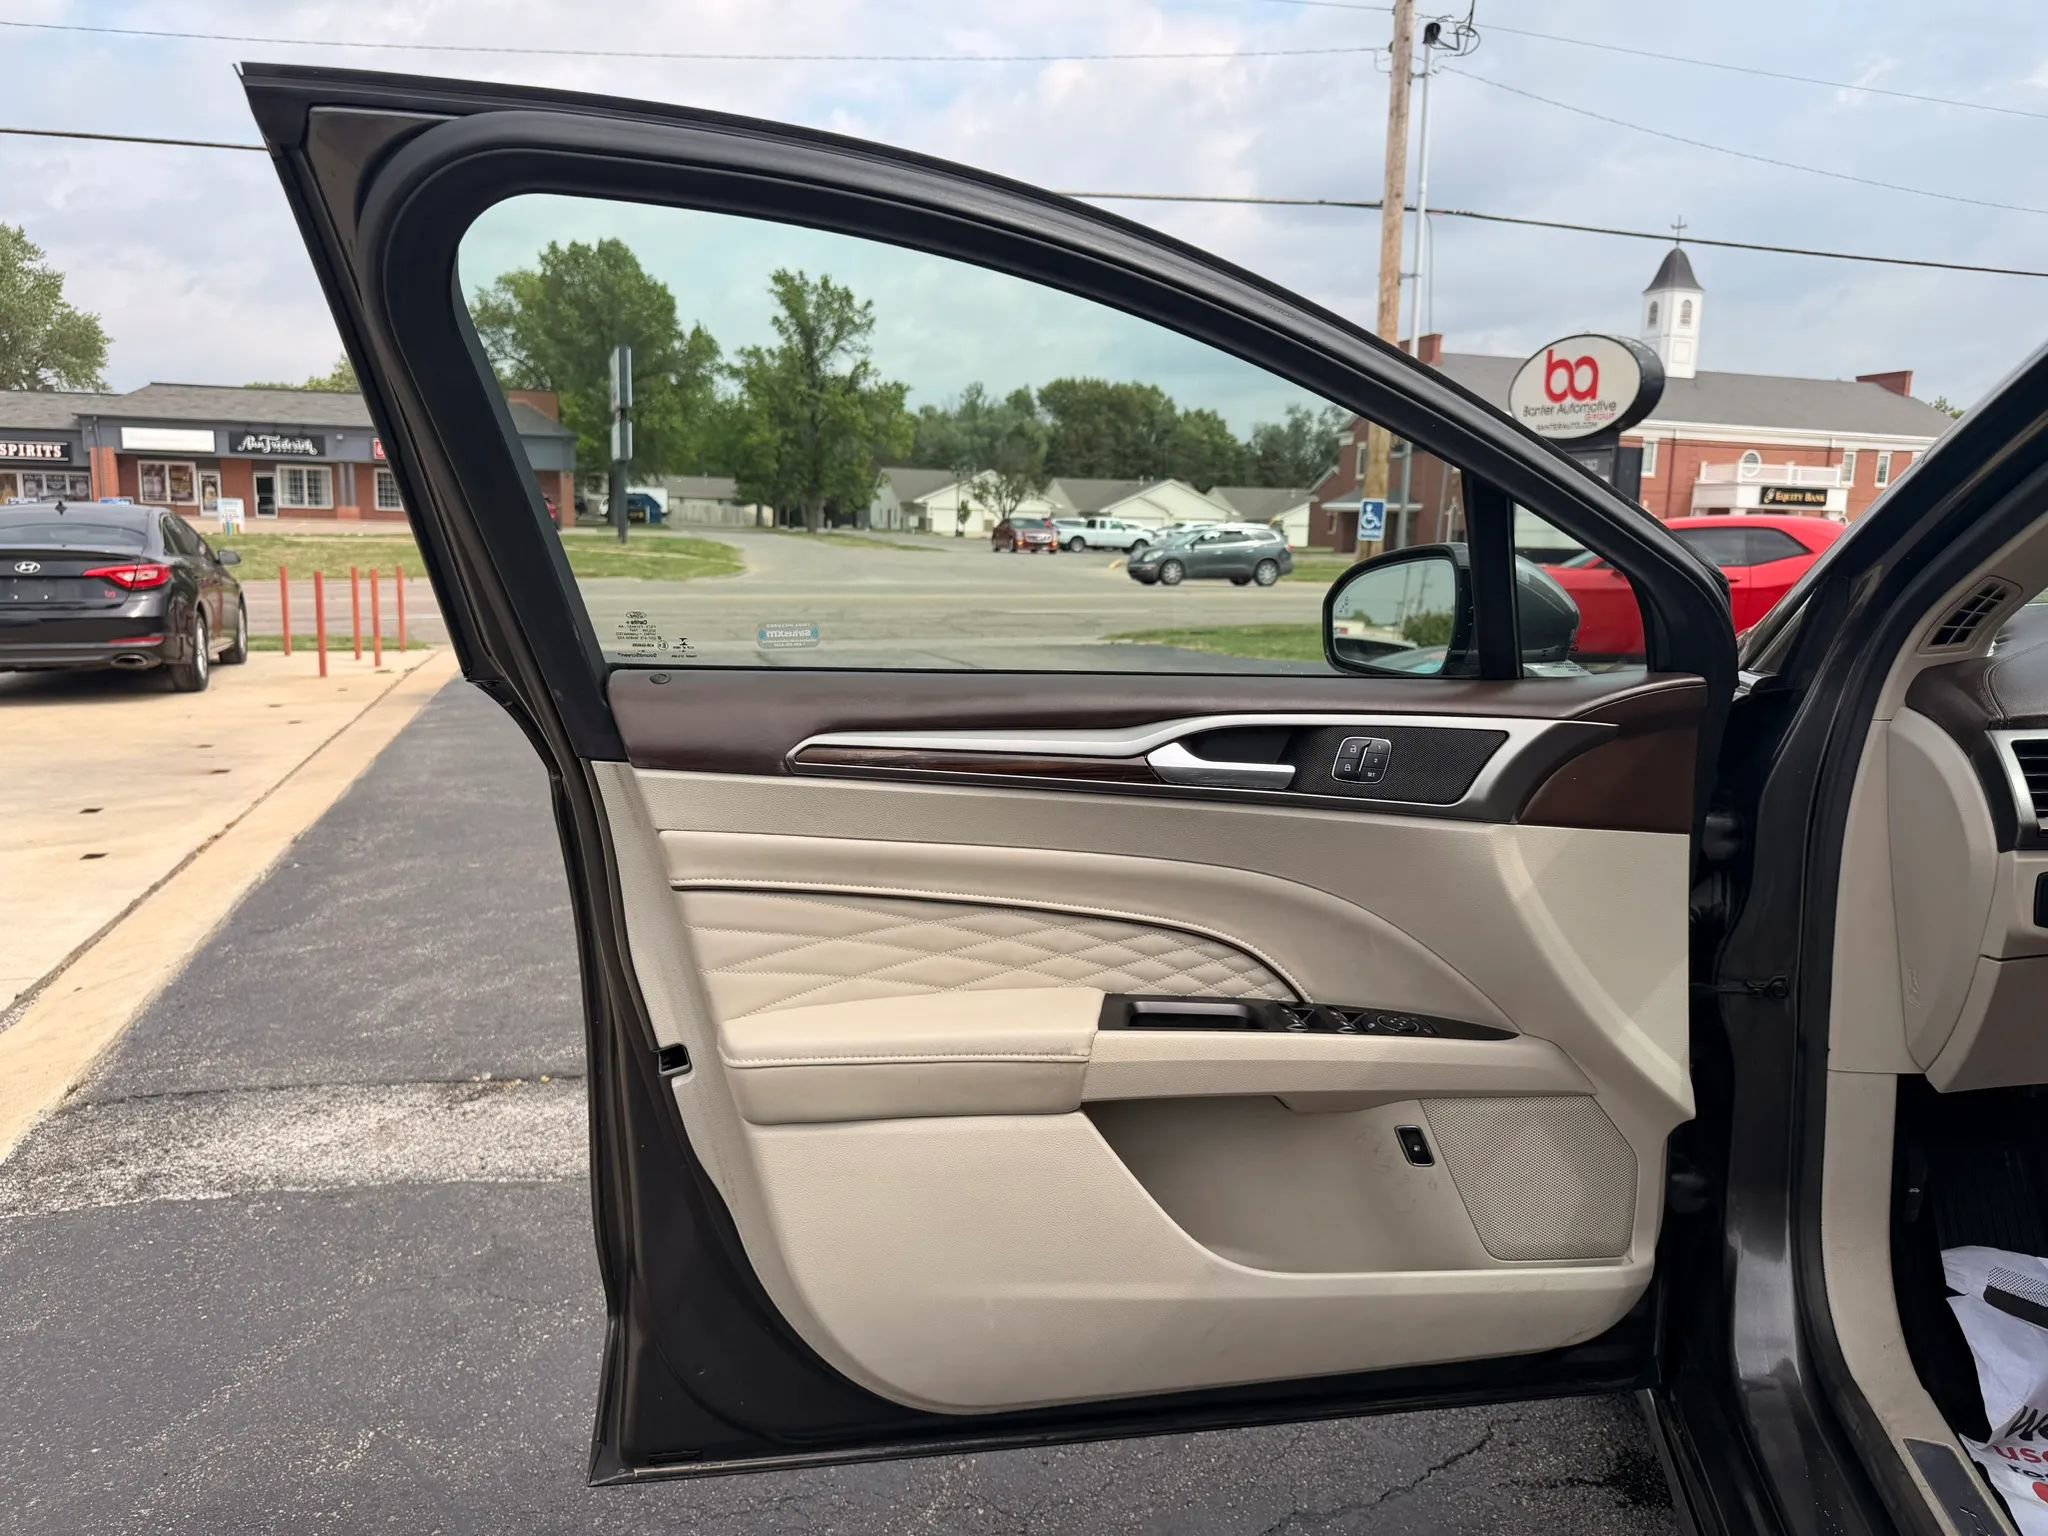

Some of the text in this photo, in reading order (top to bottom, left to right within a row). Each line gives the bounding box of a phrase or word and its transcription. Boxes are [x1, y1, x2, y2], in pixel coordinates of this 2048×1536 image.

[1544, 349, 1599, 403] ba
[1523, 400, 1617, 417] Banter Automotive
[0, 443, 61, 458] SPIRITS
